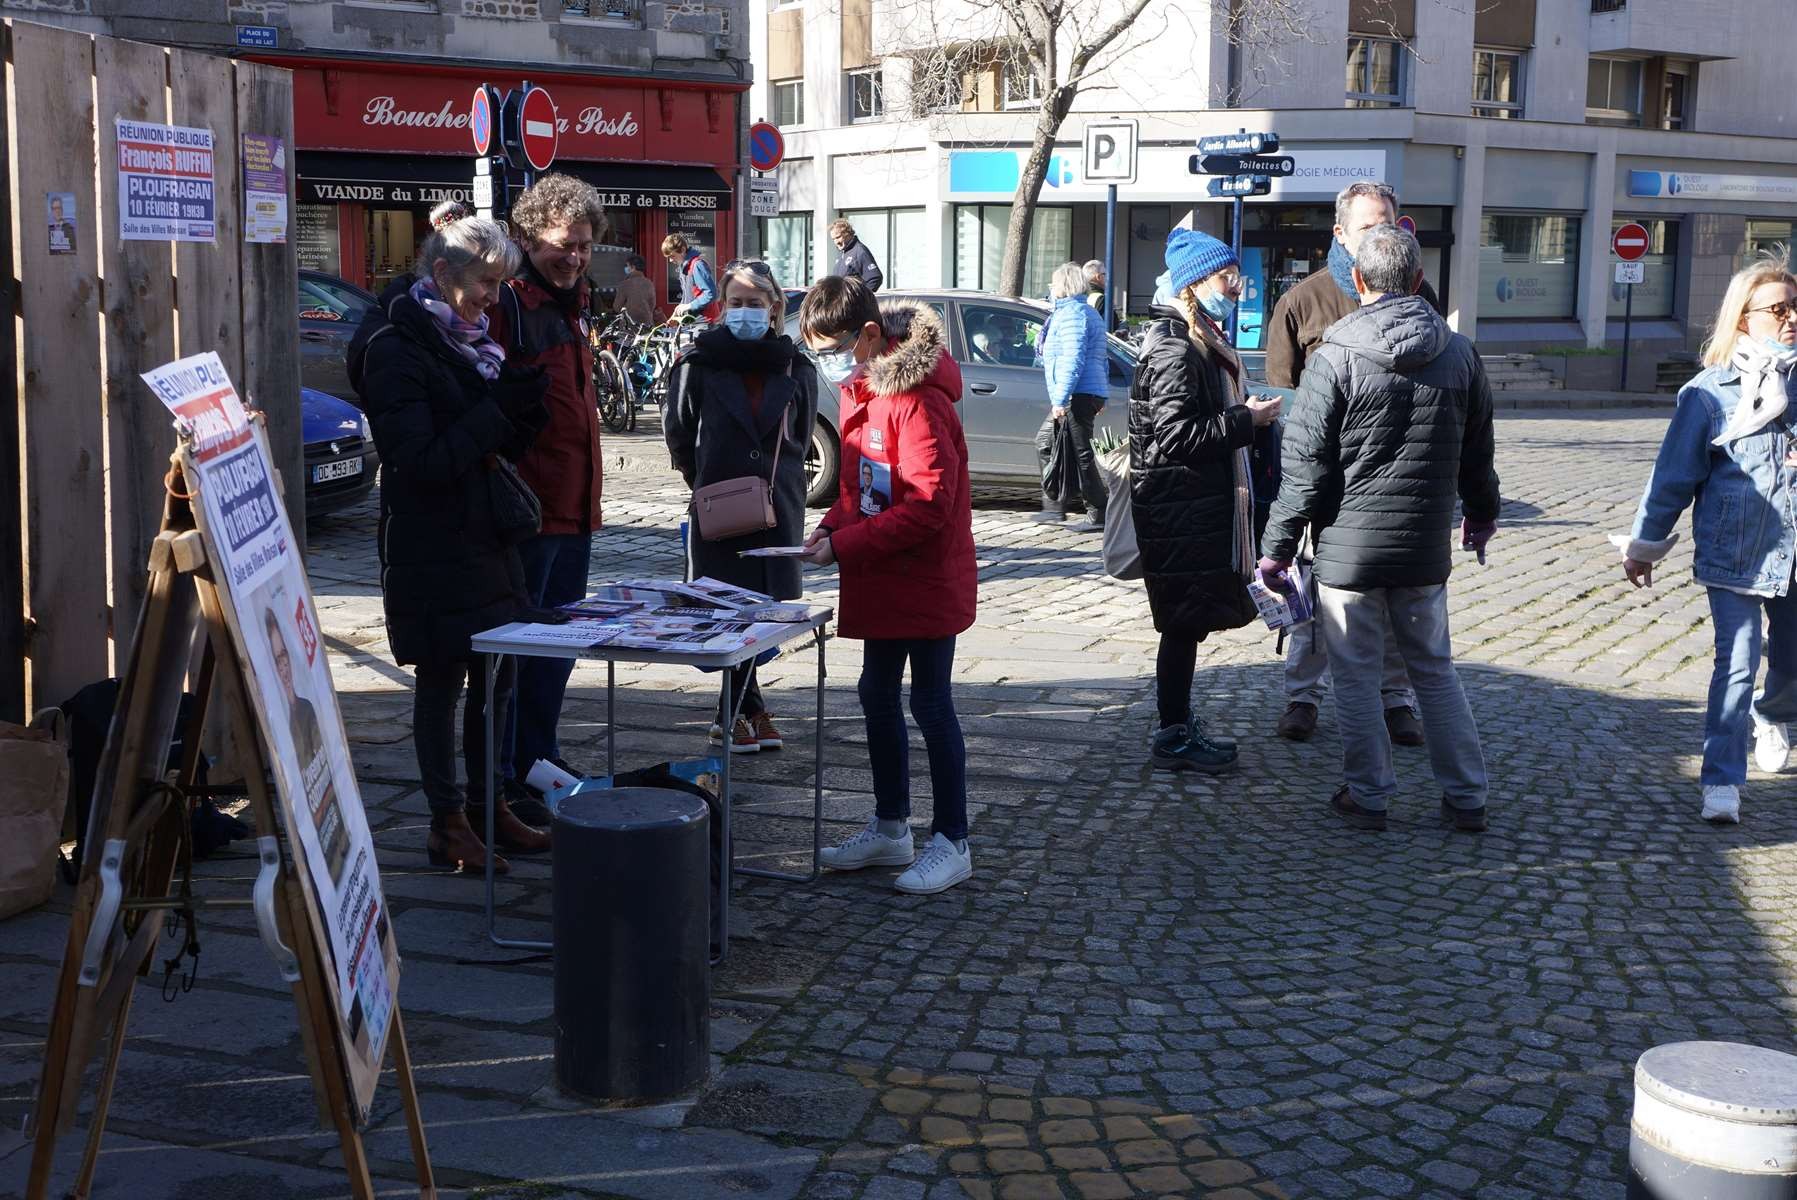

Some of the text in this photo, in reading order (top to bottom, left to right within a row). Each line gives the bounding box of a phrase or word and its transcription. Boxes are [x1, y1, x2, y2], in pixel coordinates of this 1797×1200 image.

[575, 106, 639, 137] Poste
[120, 123, 210, 147] RÉUNION PUBLIQUE
[120, 144, 211, 175] François RUFFIN
[1094, 134, 1115, 170] P
[1239, 160, 1280, 170] Toilettes
[1323, 165, 1375, 177] MÉDICALE
[129, 177, 211, 200] PLOUFRAGAN
[314, 184, 384, 200] VIANDE
[391, 187, 412, 201] du
[130, 197, 205, 218] 10 FÉVRIER 19H30
[636, 194, 653, 207] de
[659, 195, 717, 209] BRESSE
[751, 195, 775, 204] ZONE
